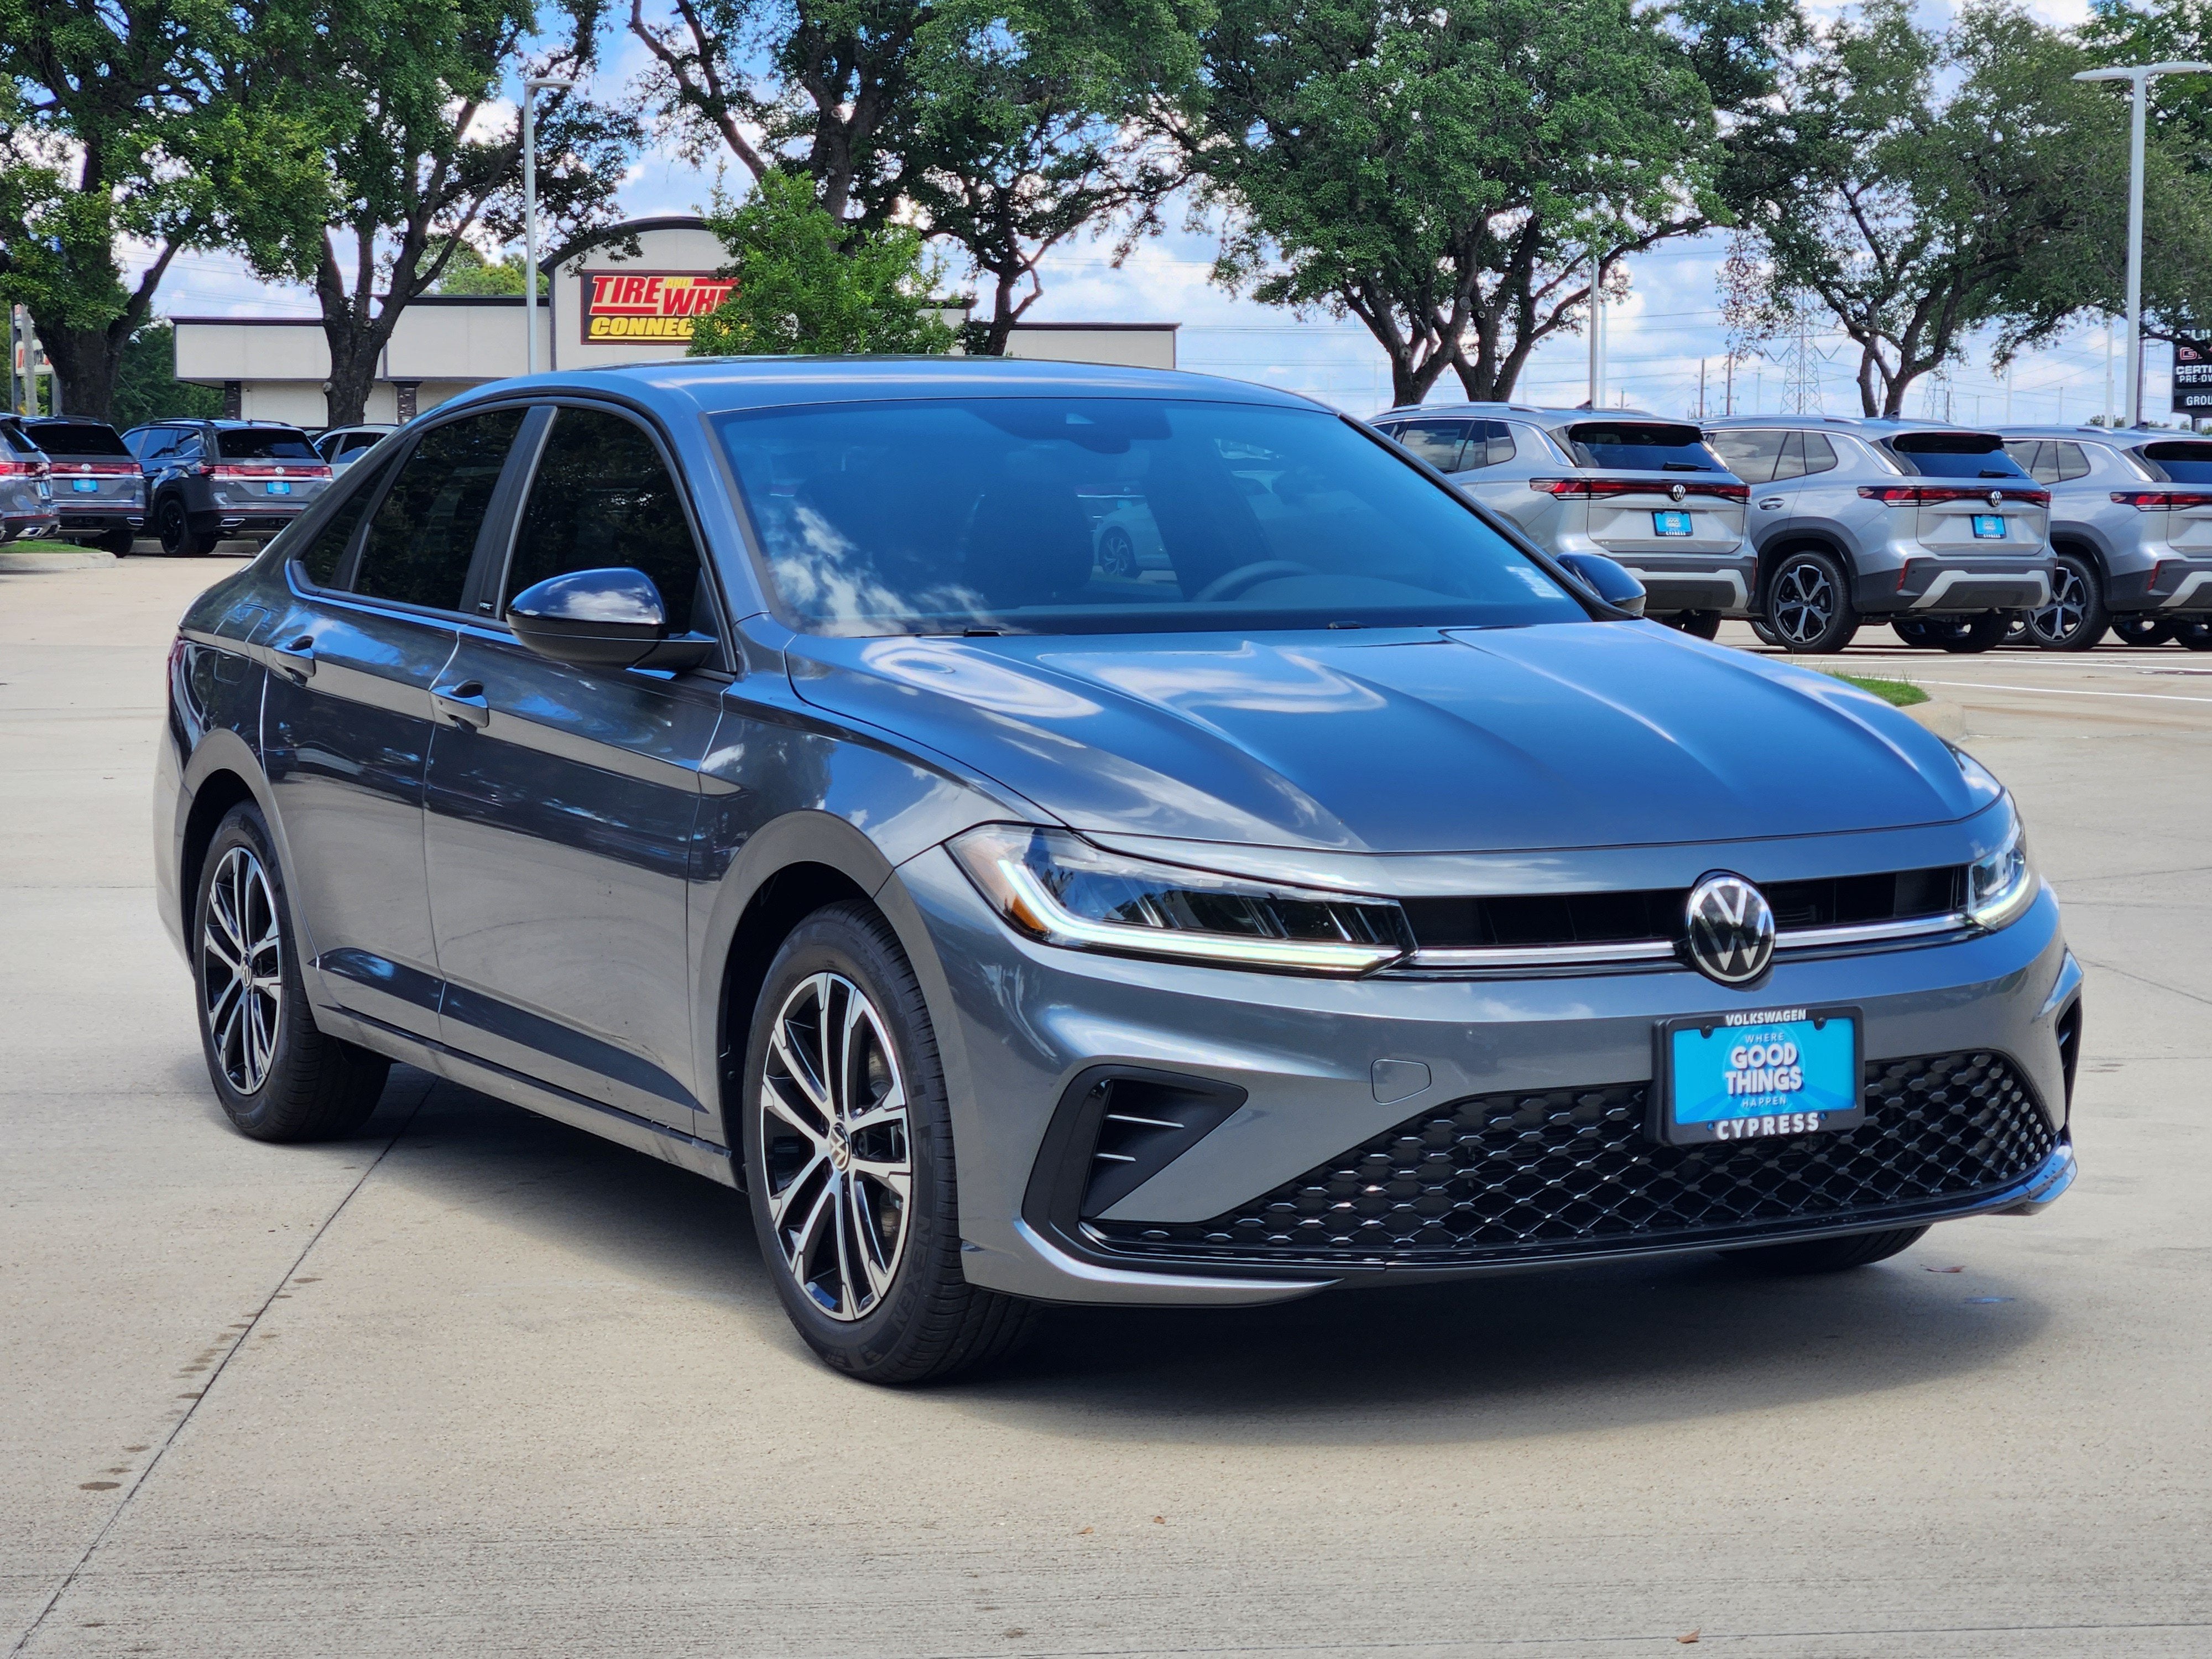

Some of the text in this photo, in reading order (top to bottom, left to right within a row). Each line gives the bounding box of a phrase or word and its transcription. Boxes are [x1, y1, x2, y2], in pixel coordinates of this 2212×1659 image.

[592, 276, 664, 304] TIRE
[665, 278, 690, 288] AND
[1688, 880, 1773, 978] VW
[1725, 1009, 1807, 1026] VOLKSWAGEN
[1745, 1032, 1785, 1043] WHERE
[1731, 1042, 1798, 1070] GOOD
[1725, 1066, 1803, 1095] THINGS
[1742, 1096, 1787, 1108] HAPPEN
[1717, 1112, 1819, 1140] CYPRESS
